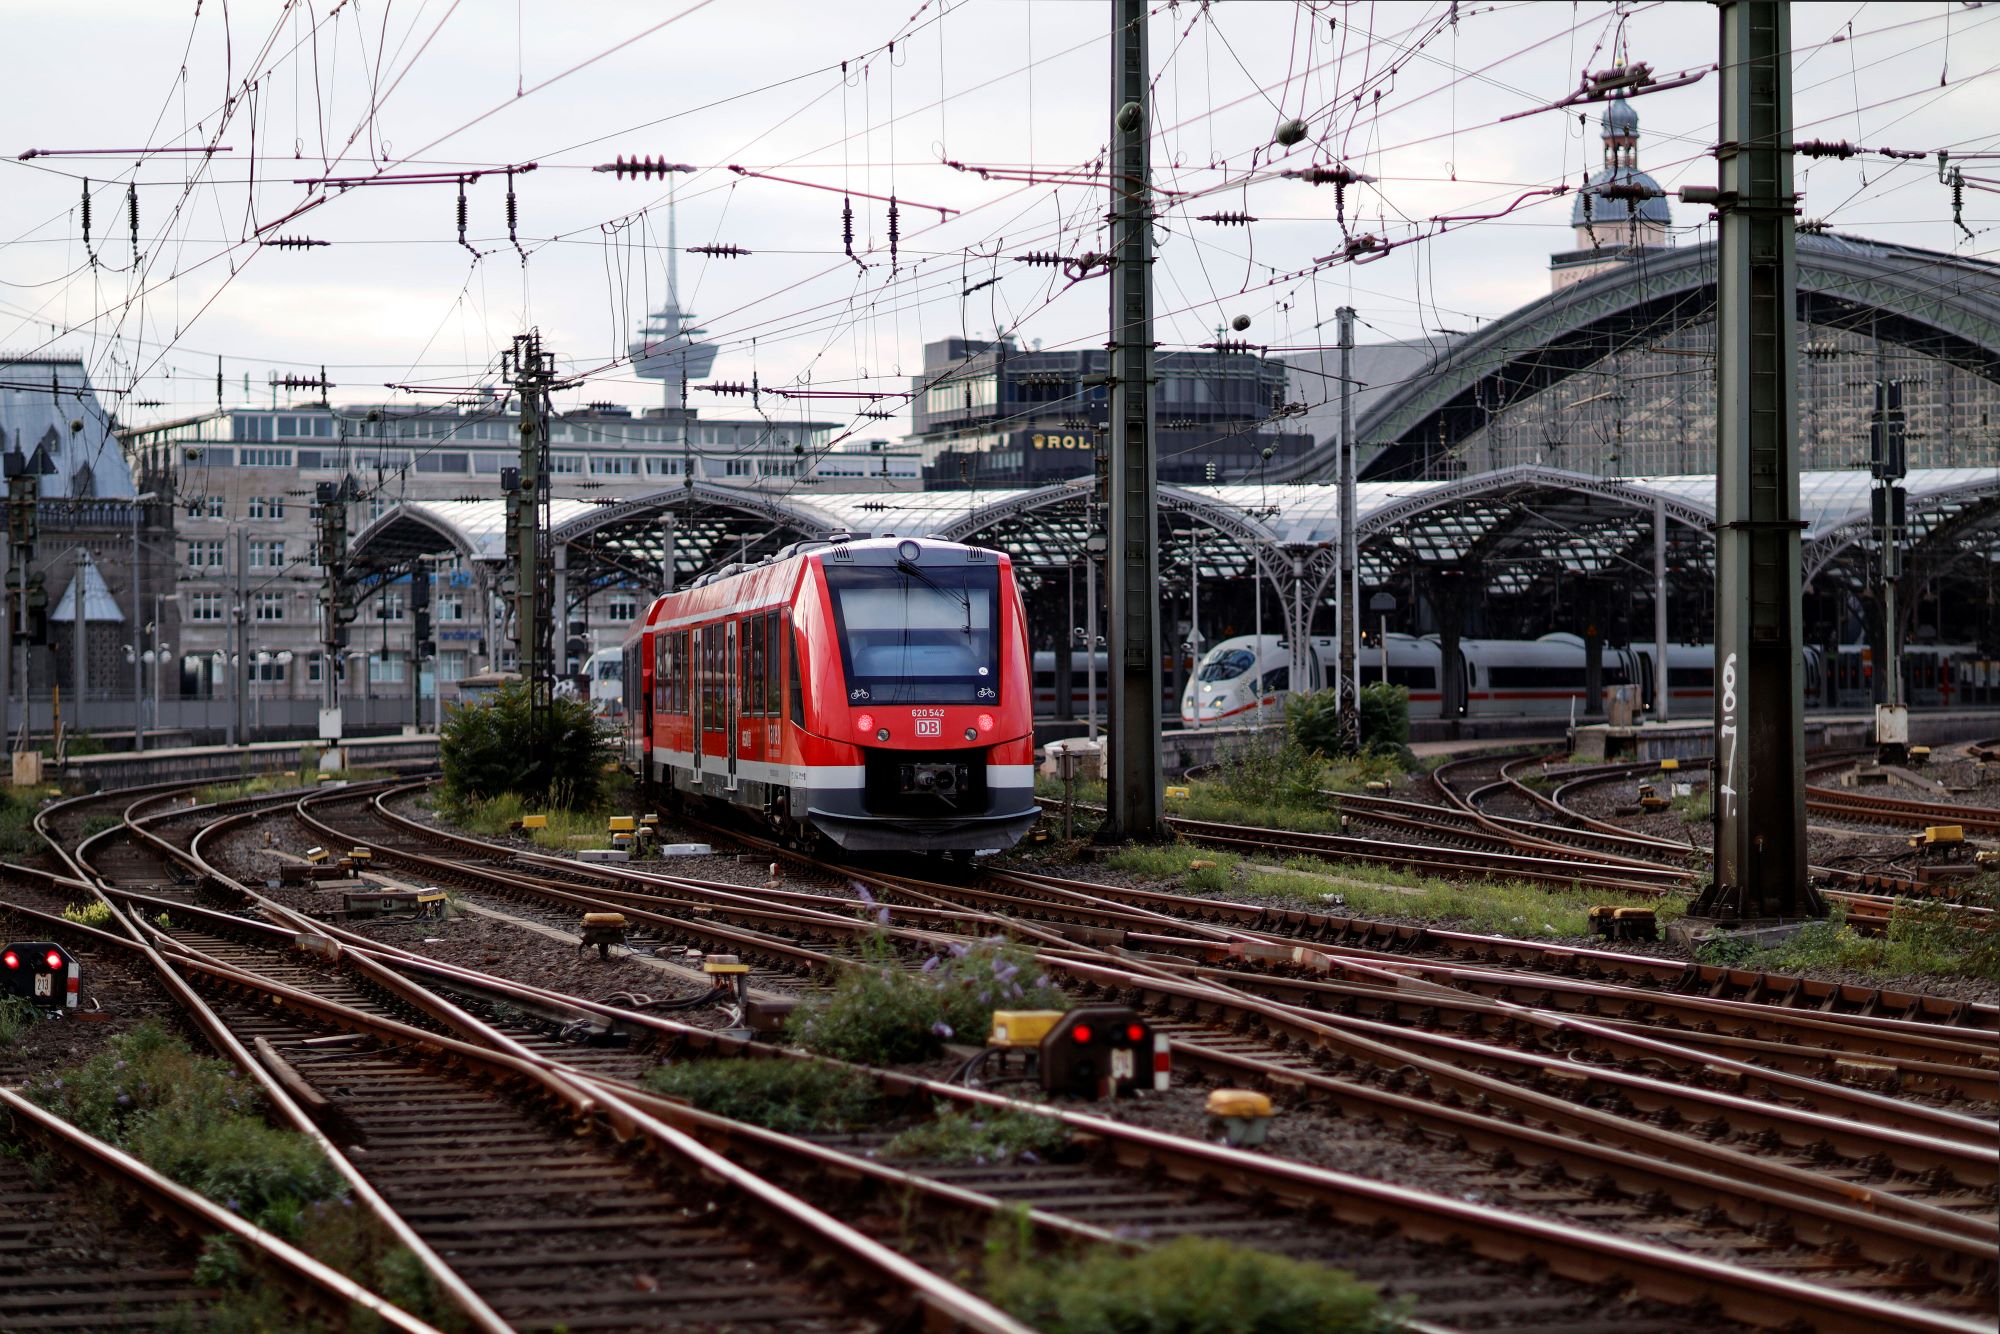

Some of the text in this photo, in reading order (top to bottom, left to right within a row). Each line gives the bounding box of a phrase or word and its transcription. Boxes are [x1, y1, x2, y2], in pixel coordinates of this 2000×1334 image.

[1047, 435, 1095, 449] ROL
[911, 709, 945, 717] 620 542
[917, 720, 939, 735] DB
[37, 978, 49, 991] 213
